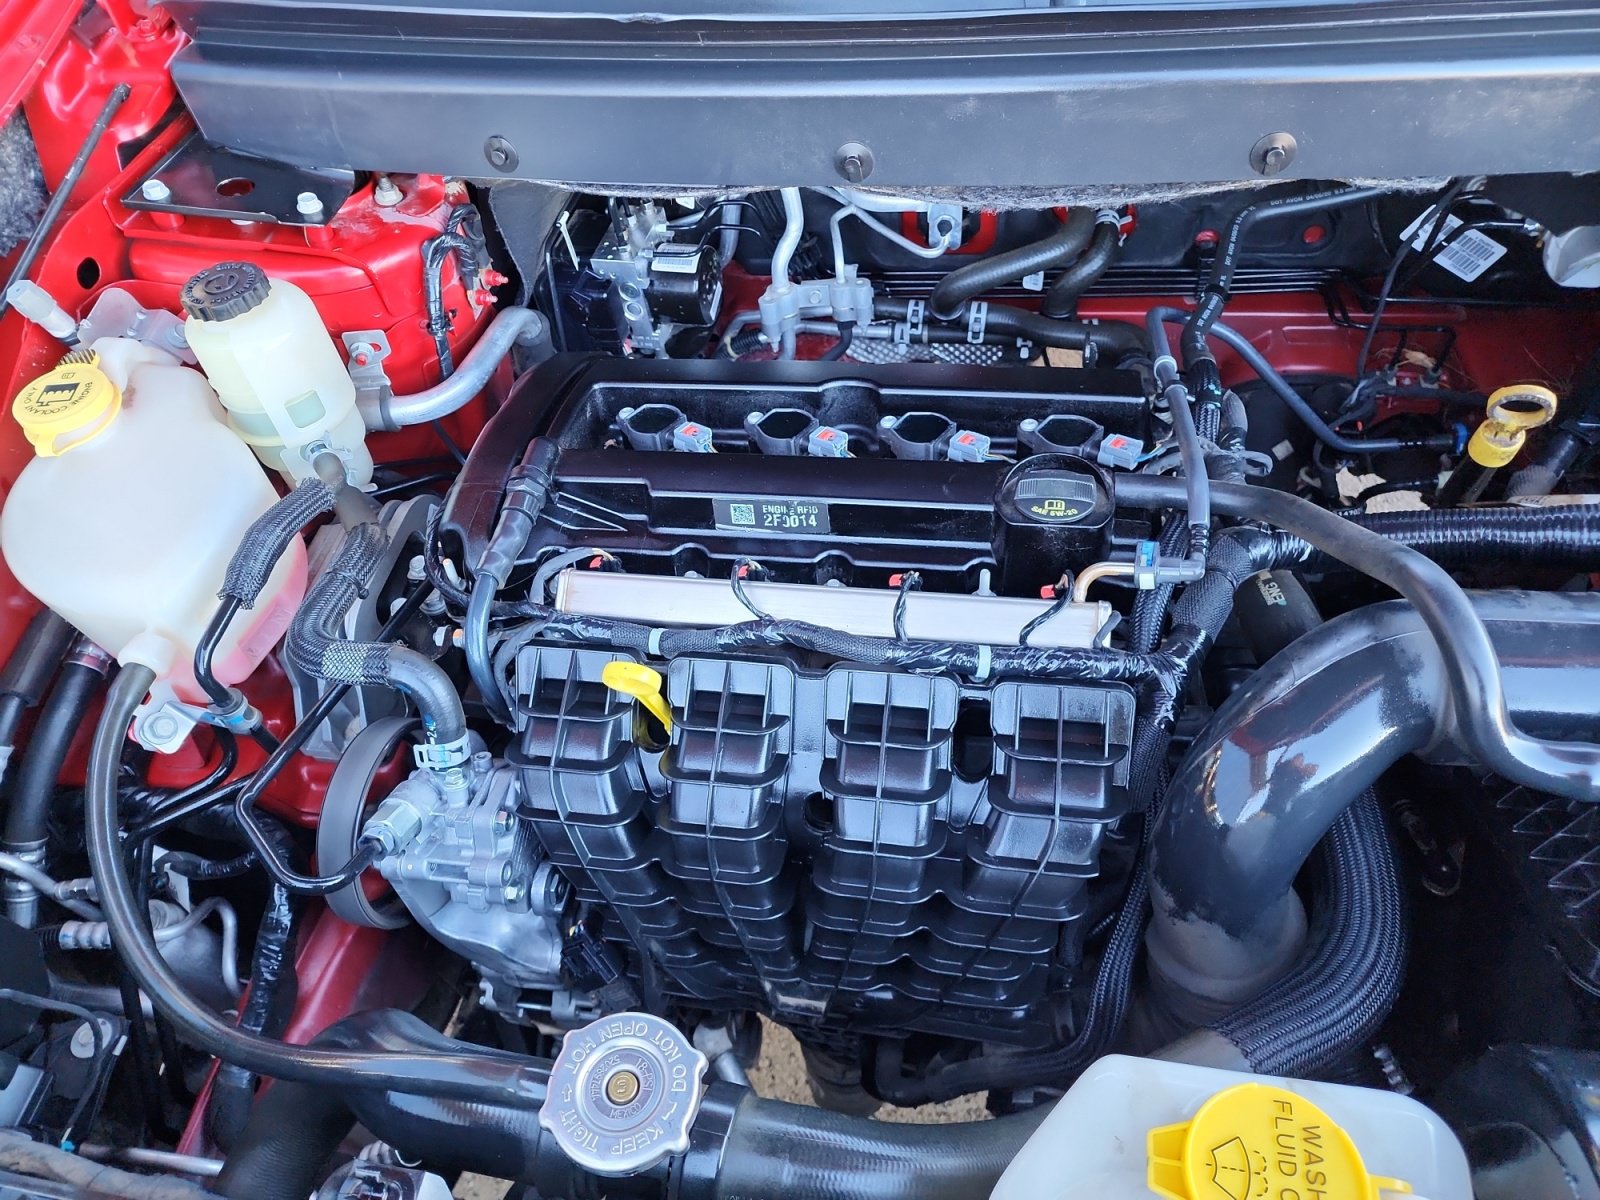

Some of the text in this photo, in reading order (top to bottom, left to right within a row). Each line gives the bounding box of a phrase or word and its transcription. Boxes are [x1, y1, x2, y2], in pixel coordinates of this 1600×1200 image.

[71, 382, 93, 405] ENGINE
[25, 405, 68, 416] COOLANT
[797, 505, 819, 514] RFID
[1031, 505, 1078, 517] SAE 5W-20
[565, 1020, 687, 1092] DO NOT OPEN HOT
[609, 1102, 641, 1119] MEXICO
[560, 1108, 664, 1155] KEEP TIGHT
[1273, 1100, 1298, 1176] FLUID
